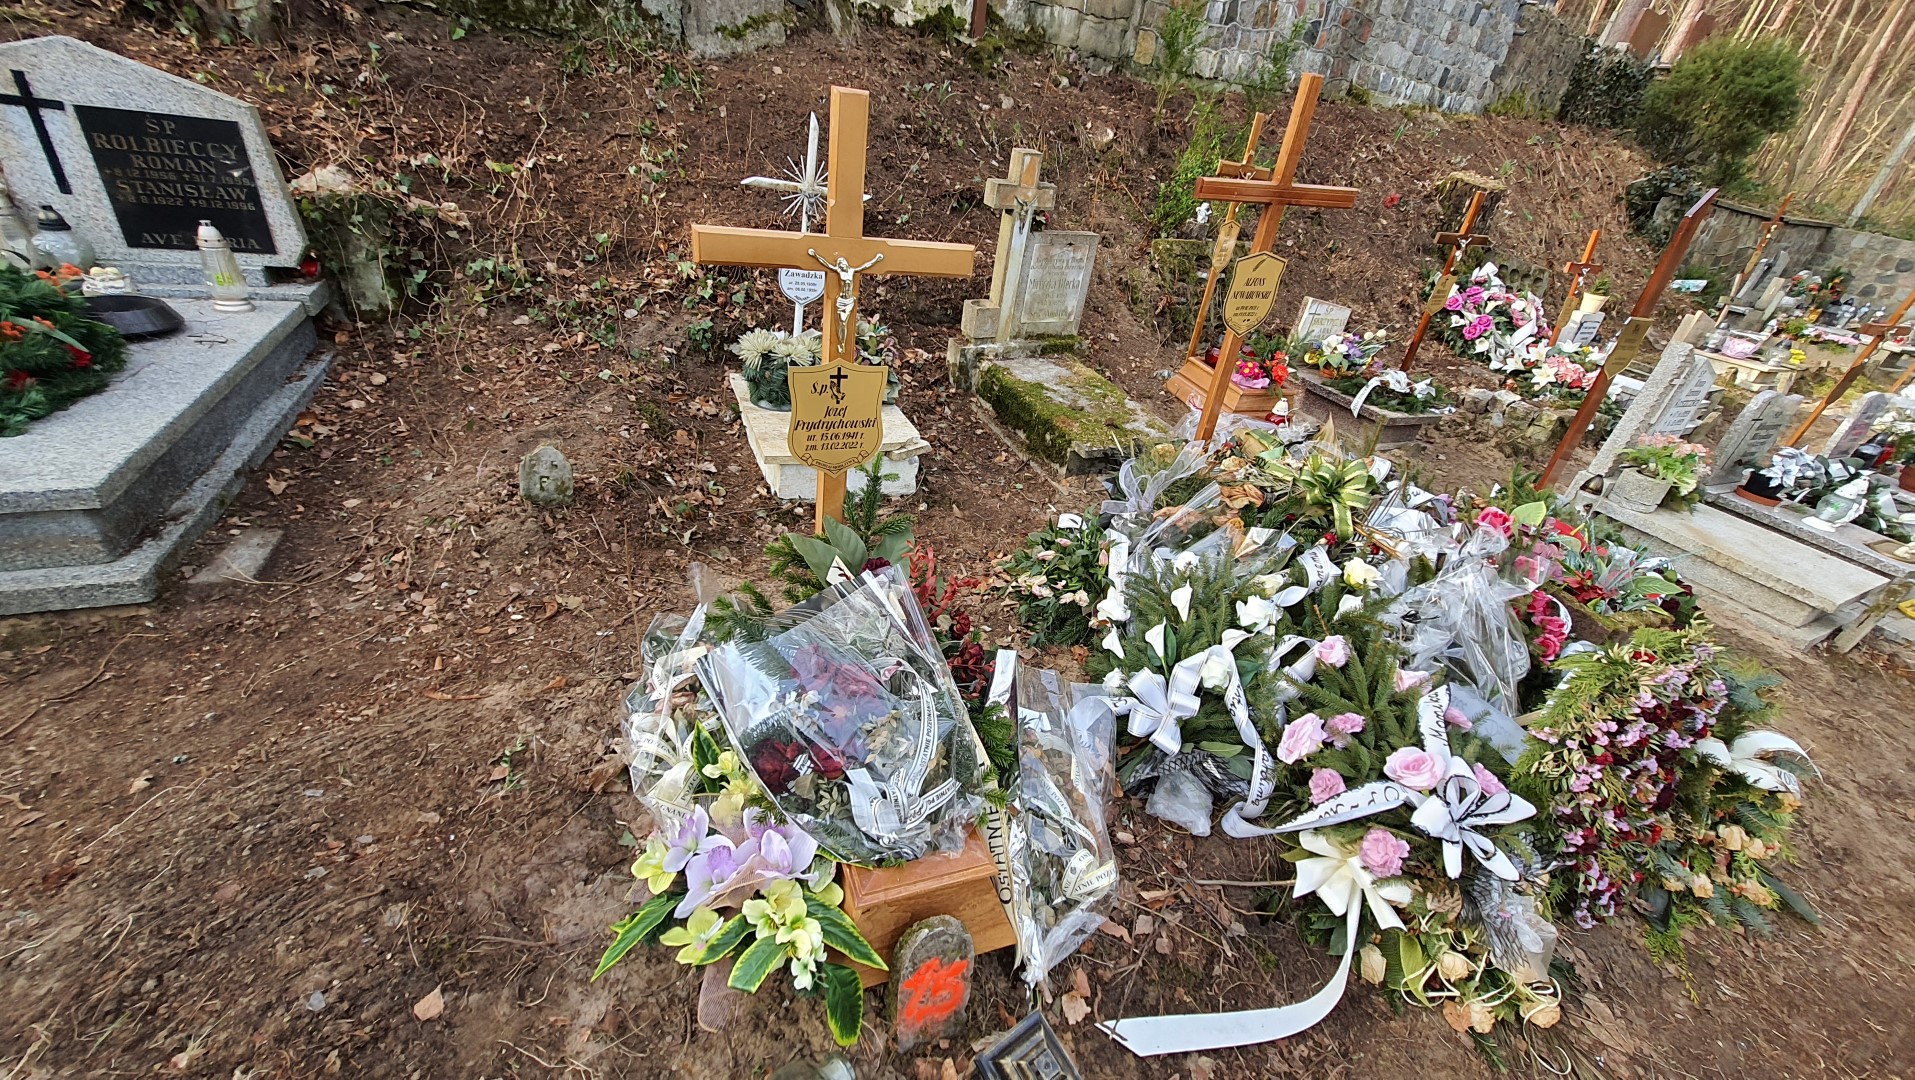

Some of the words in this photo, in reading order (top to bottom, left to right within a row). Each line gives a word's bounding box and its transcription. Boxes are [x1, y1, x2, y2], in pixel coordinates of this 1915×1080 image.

[91, 132, 238, 160] ROLBIECCY
[129, 154, 217, 175] ROMAN
[115, 179, 248, 202] STANISŁAW
[141, 233, 186, 246] AVE
[784, 270, 823, 280] Zawadzka
[806, 434, 818, 442] ur.
[805, 443, 818, 451] zm.
[1424, 691, 1449, 747] Monika
